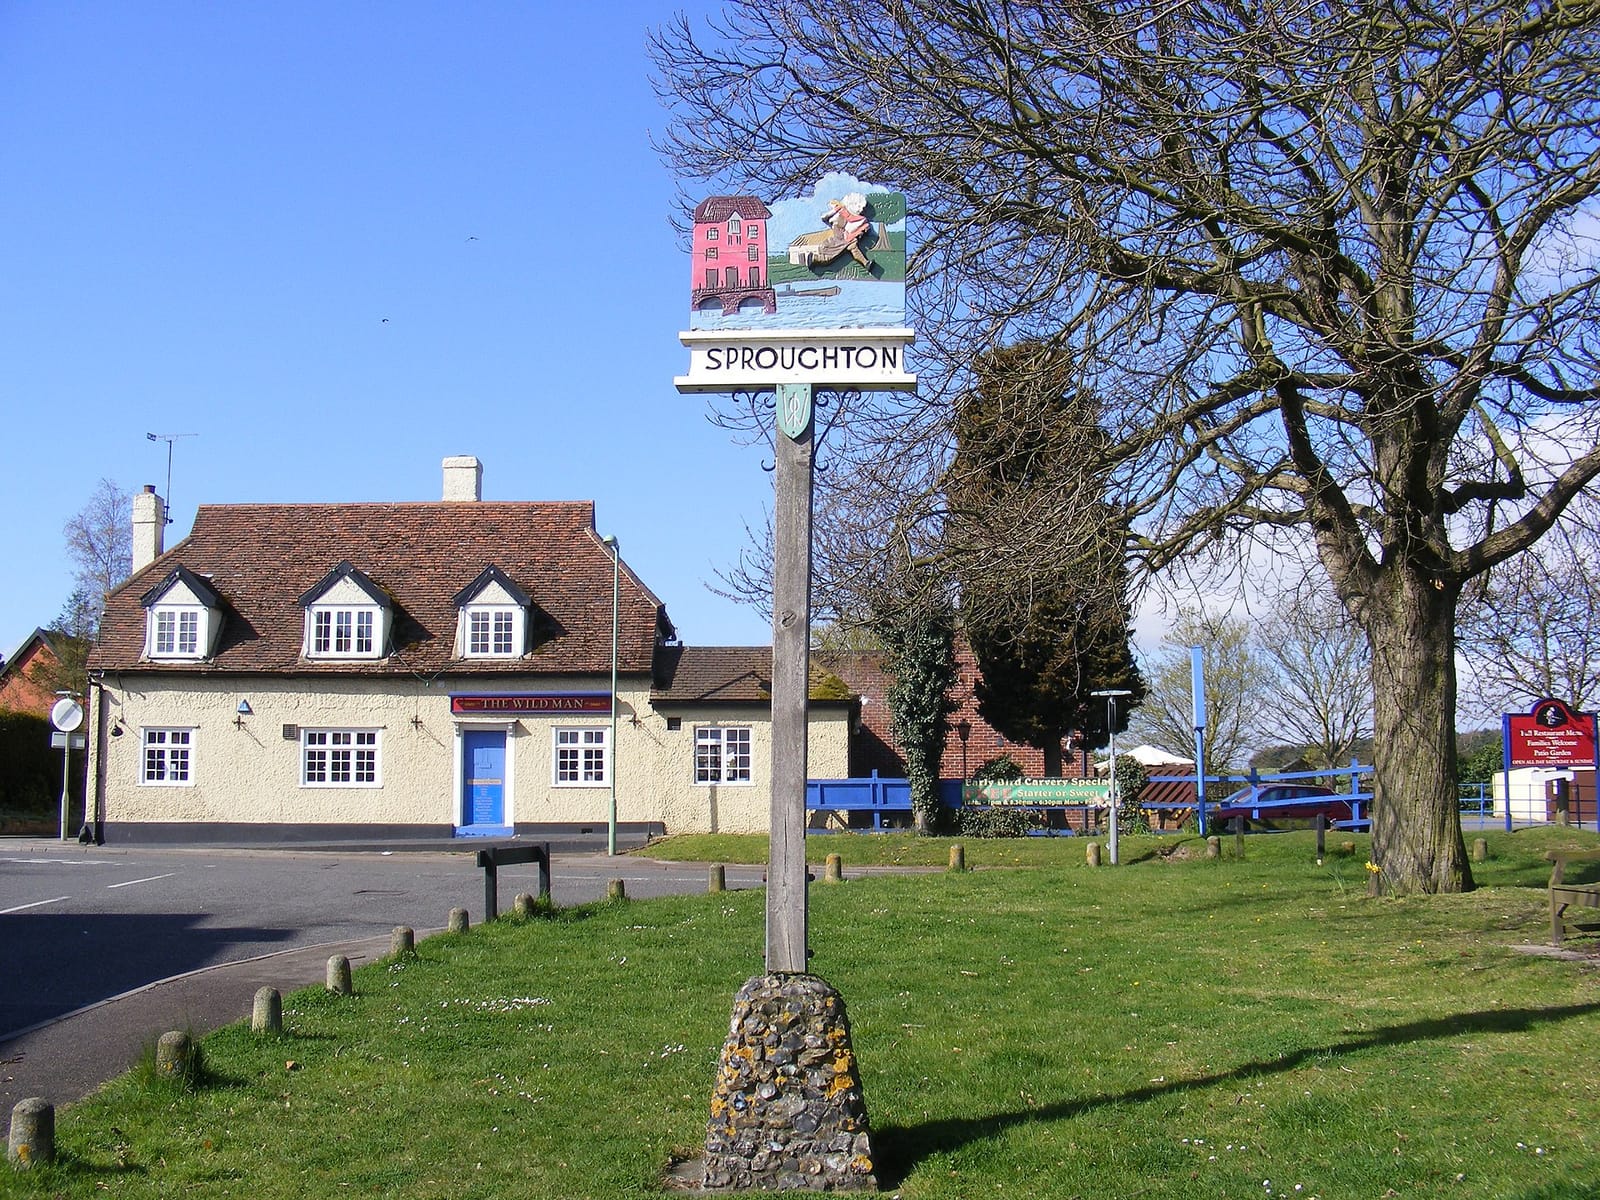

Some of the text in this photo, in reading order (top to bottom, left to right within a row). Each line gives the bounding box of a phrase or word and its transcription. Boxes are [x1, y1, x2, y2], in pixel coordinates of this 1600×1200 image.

[705, 346, 897, 370] SPROUGHTON
[481, 699, 584, 709] THE WILD MAN
[1527, 739, 1551, 747] Families
[965, 778, 994, 788] Early
[997, 777, 1021, 786] Bird
[1024, 777, 1068, 788] Carvery
[1017, 788, 1052, 797] Starter
[1069, 788, 1099, 798] Sweet
